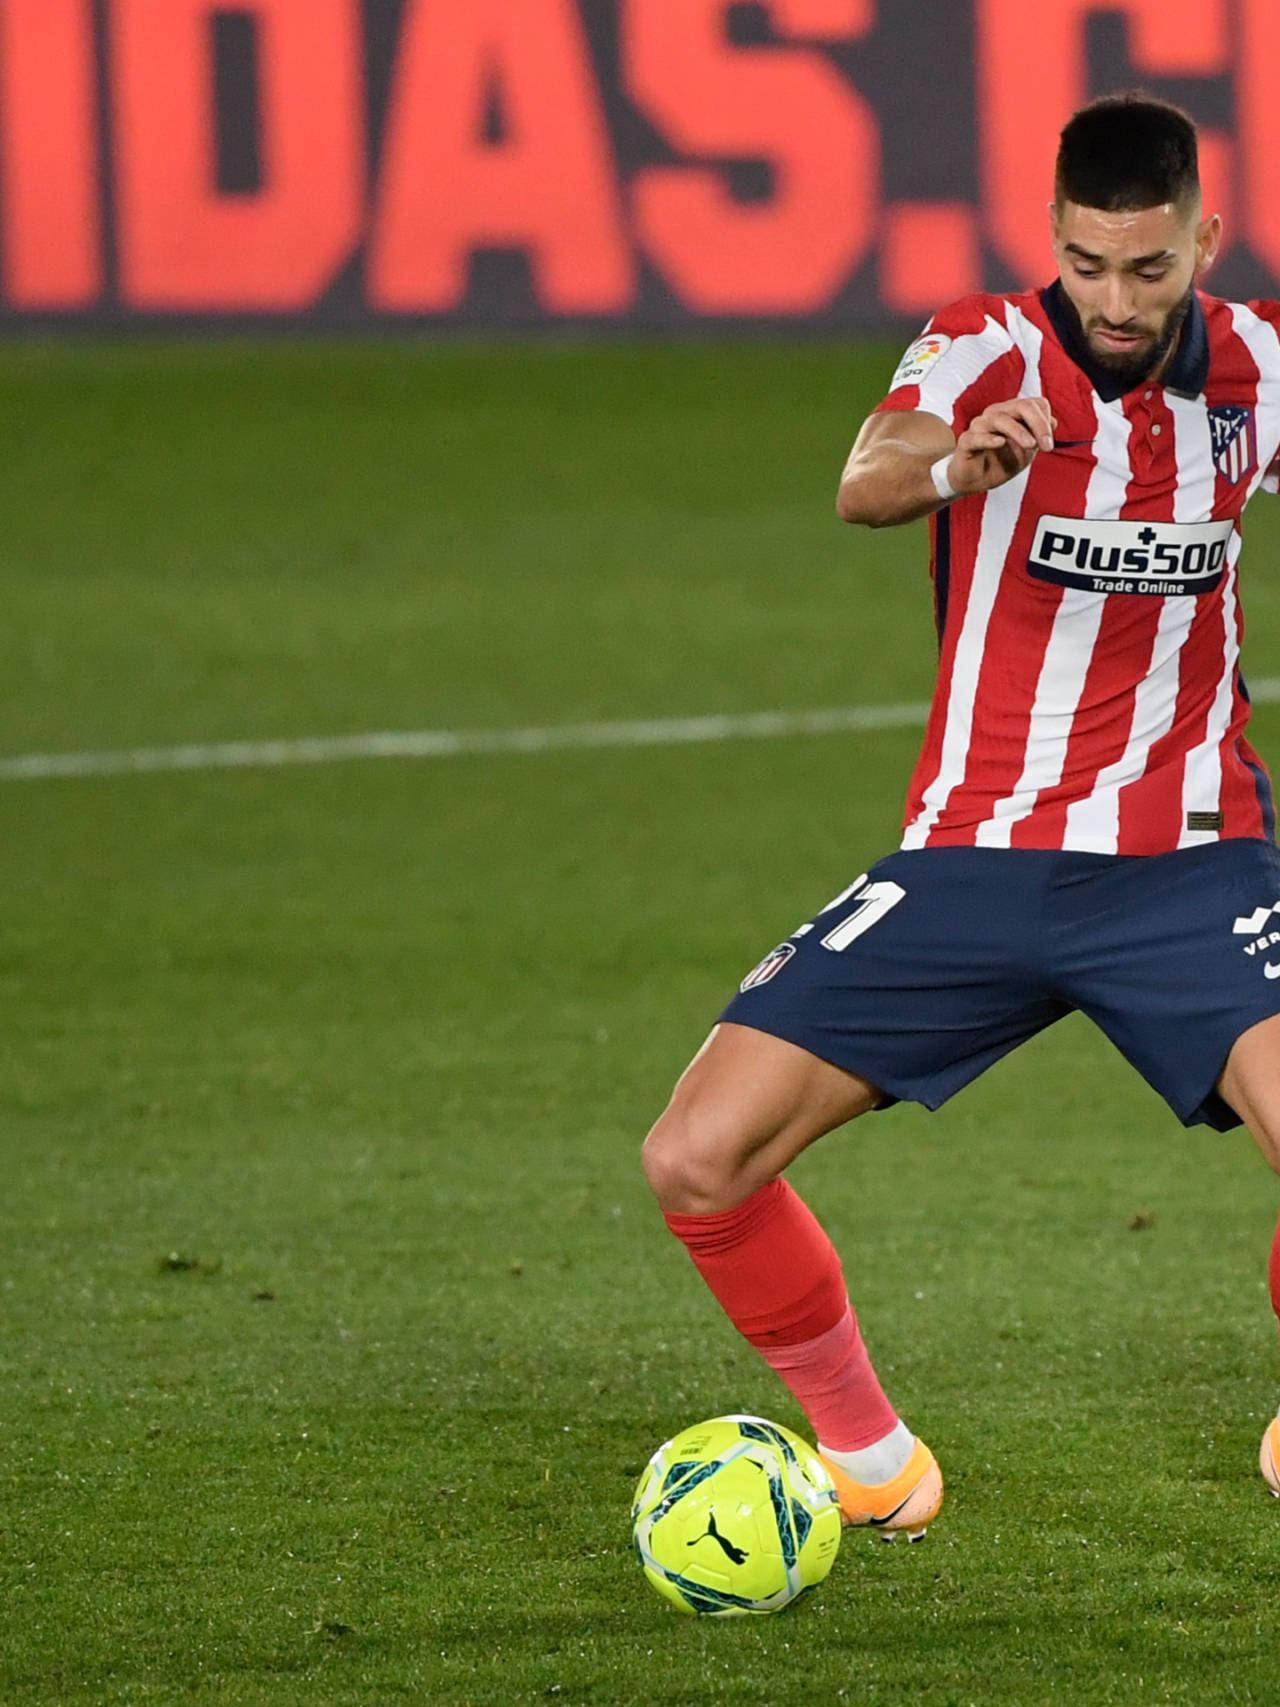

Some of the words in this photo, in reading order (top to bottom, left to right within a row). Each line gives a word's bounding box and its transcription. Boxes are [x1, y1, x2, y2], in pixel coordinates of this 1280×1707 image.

[1038, 529, 1226, 575] Plus500
[1092, 578, 1133, 593] Trade
[1138, 580, 1185, 594] Online
